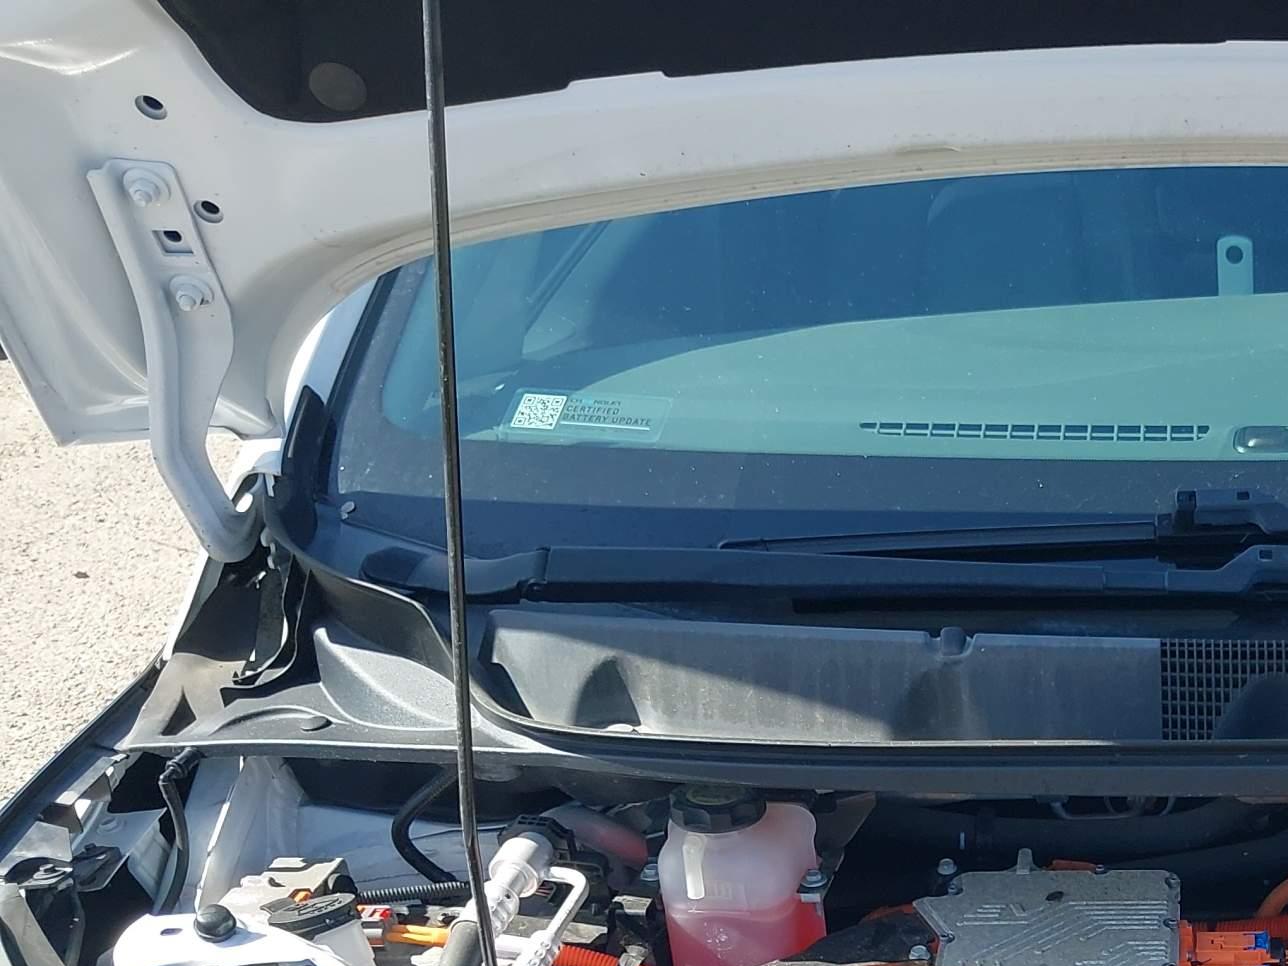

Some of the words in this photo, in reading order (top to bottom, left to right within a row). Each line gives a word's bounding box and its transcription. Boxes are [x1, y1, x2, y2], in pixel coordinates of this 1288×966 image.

[566, 405, 620, 415] CERTIFIED
[563, 413, 608, 424] BATTERY
[612, 416, 652, 426] UPDATE
